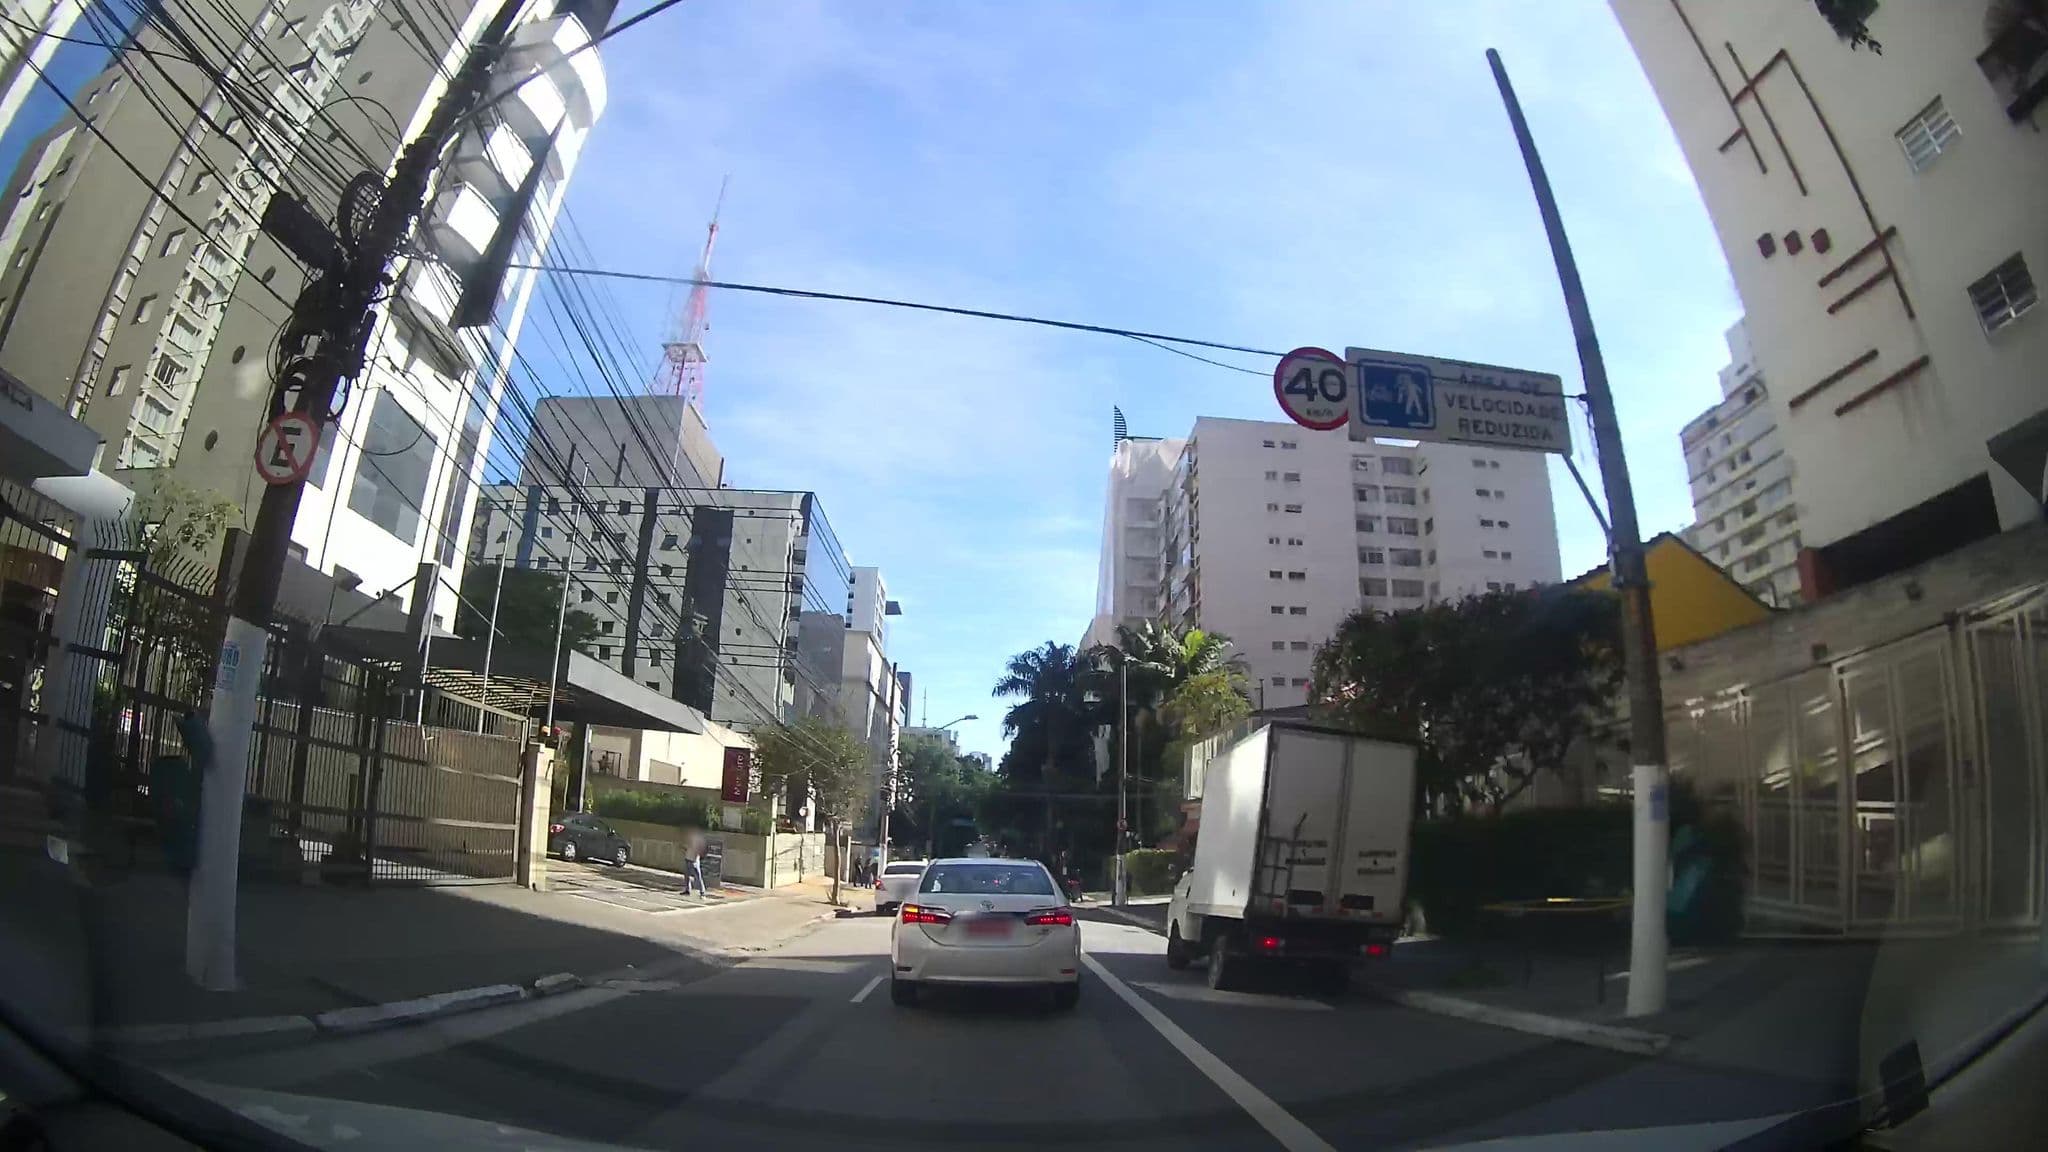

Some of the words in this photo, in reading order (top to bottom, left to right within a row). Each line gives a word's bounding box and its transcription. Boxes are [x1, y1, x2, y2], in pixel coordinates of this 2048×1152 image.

[1284, 367, 1347, 403] 40
[1443, 392, 1562, 421] VELOCIDADE
[1458, 417, 1555, 441] REDUZIDA
[733, 753, 745, 796] Mure
